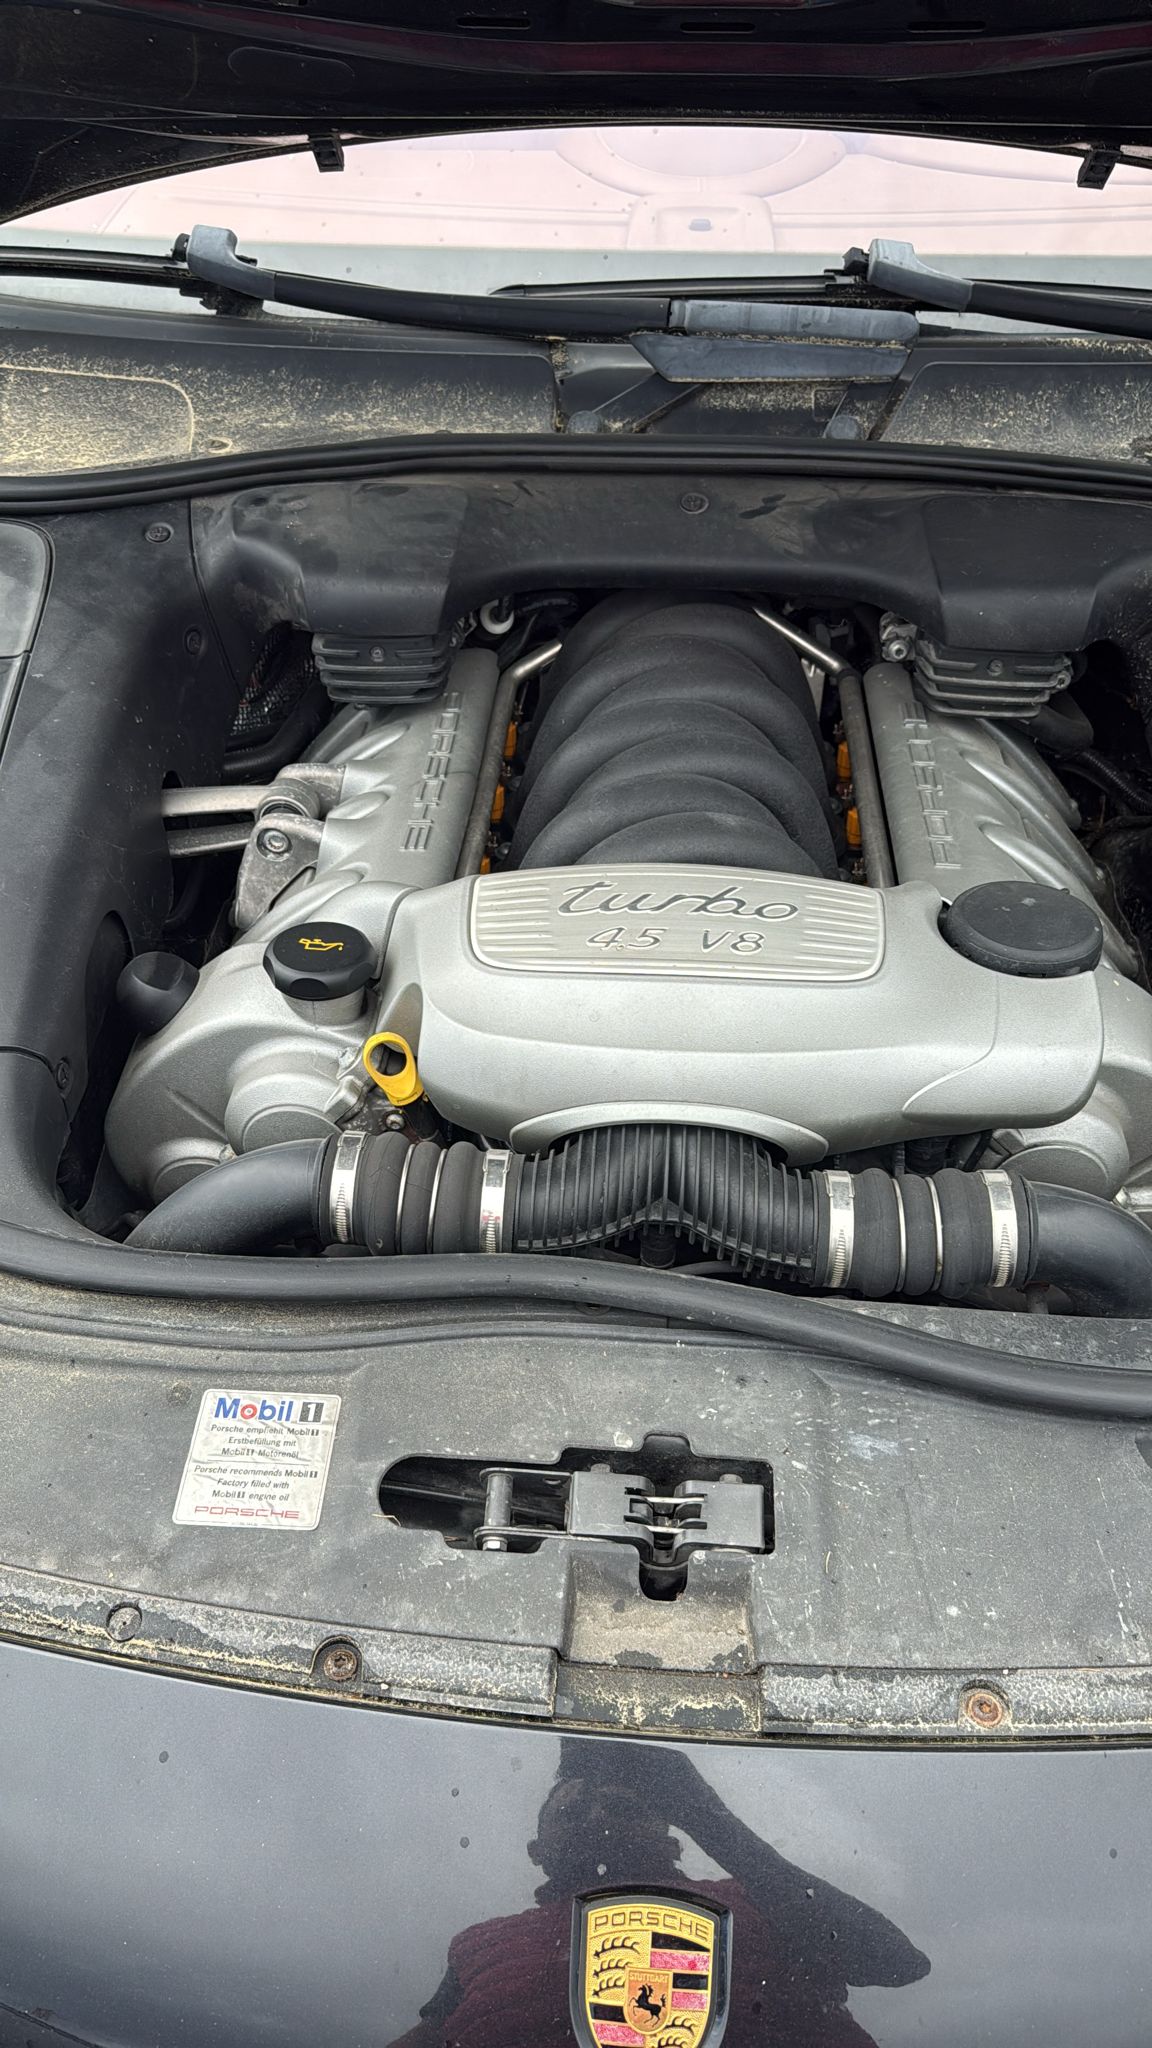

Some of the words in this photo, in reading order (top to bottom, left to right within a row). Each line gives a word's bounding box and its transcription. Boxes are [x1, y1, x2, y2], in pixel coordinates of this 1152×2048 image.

[400, 692, 462, 851] PORSCHE
[902, 702, 961, 869] PORSCHE
[557, 880, 799, 921] turbo
[586, 926, 666, 951] 4.5
[701, 928, 765, 955] V8
[214, 1397, 294, 1422] Mobil
[303, 1402, 321, 1422] 1
[211, 1424, 244, 1433] Porsche
[228, 1436, 281, 1447] Erstbefüllung
[283, 1439, 296, 1447] mit
[194, 1465, 227, 1474] Porsche
[230, 1467, 282, 1477] recommends
[217, 1478, 248, 1488] Factory
[251, 1479, 271, 1488] filled
[273, 1481, 289, 1489] with
[249, 1493, 276, 1501] engine
[279, 1493, 289, 1501] oil
[194, 1506, 300, 1519] PORSCHE
[594, 1910, 709, 1942] PORSCHE
